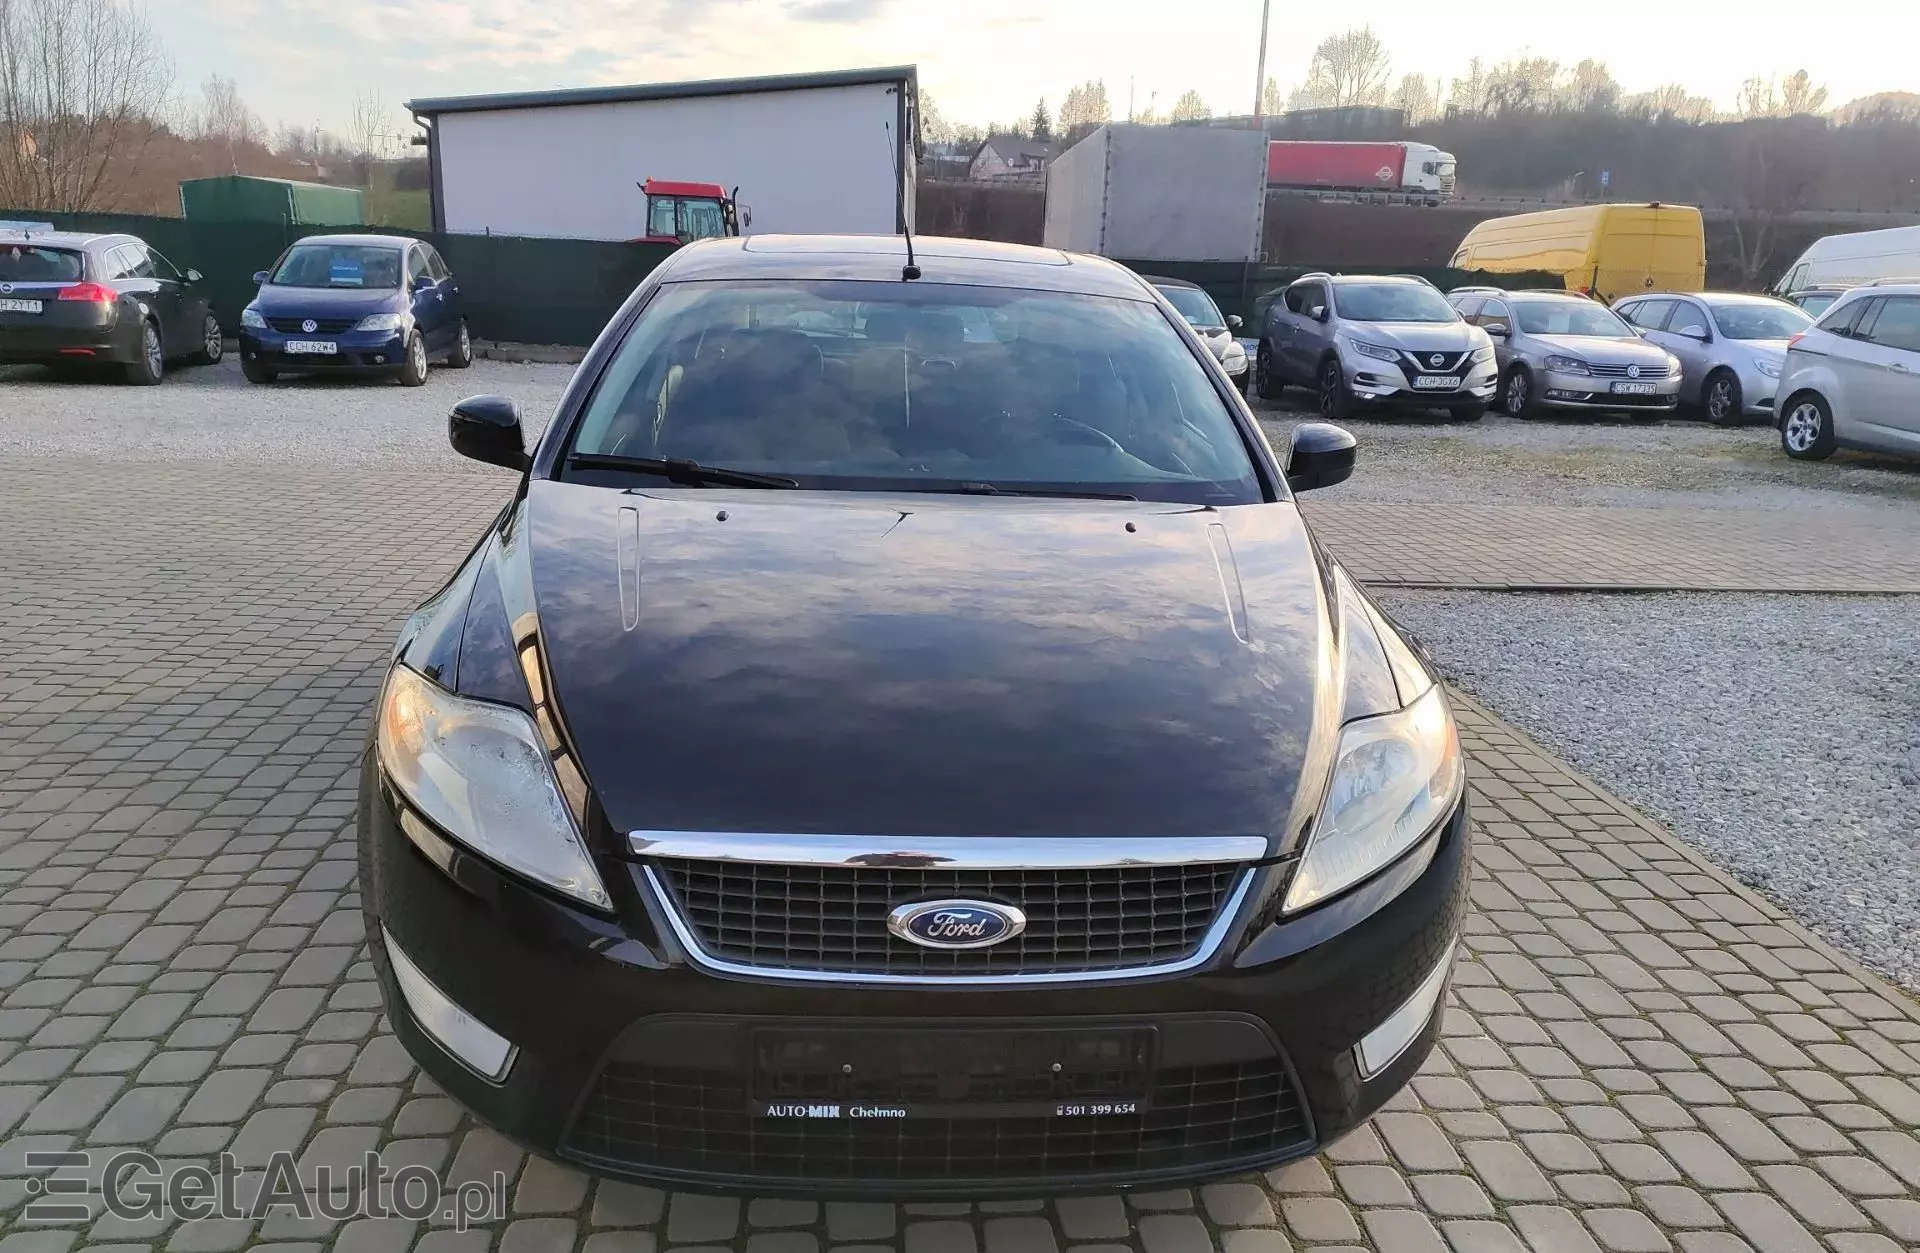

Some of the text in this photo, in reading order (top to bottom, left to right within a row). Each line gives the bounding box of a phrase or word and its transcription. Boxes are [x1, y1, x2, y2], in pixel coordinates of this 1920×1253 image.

[289, 341, 335, 352] CCH 62W4
[1418, 376, 1459, 387] CCH 3GX6
[926, 911, 988, 938] Ford
[1065, 1103, 1136, 1116] 501 399 654
